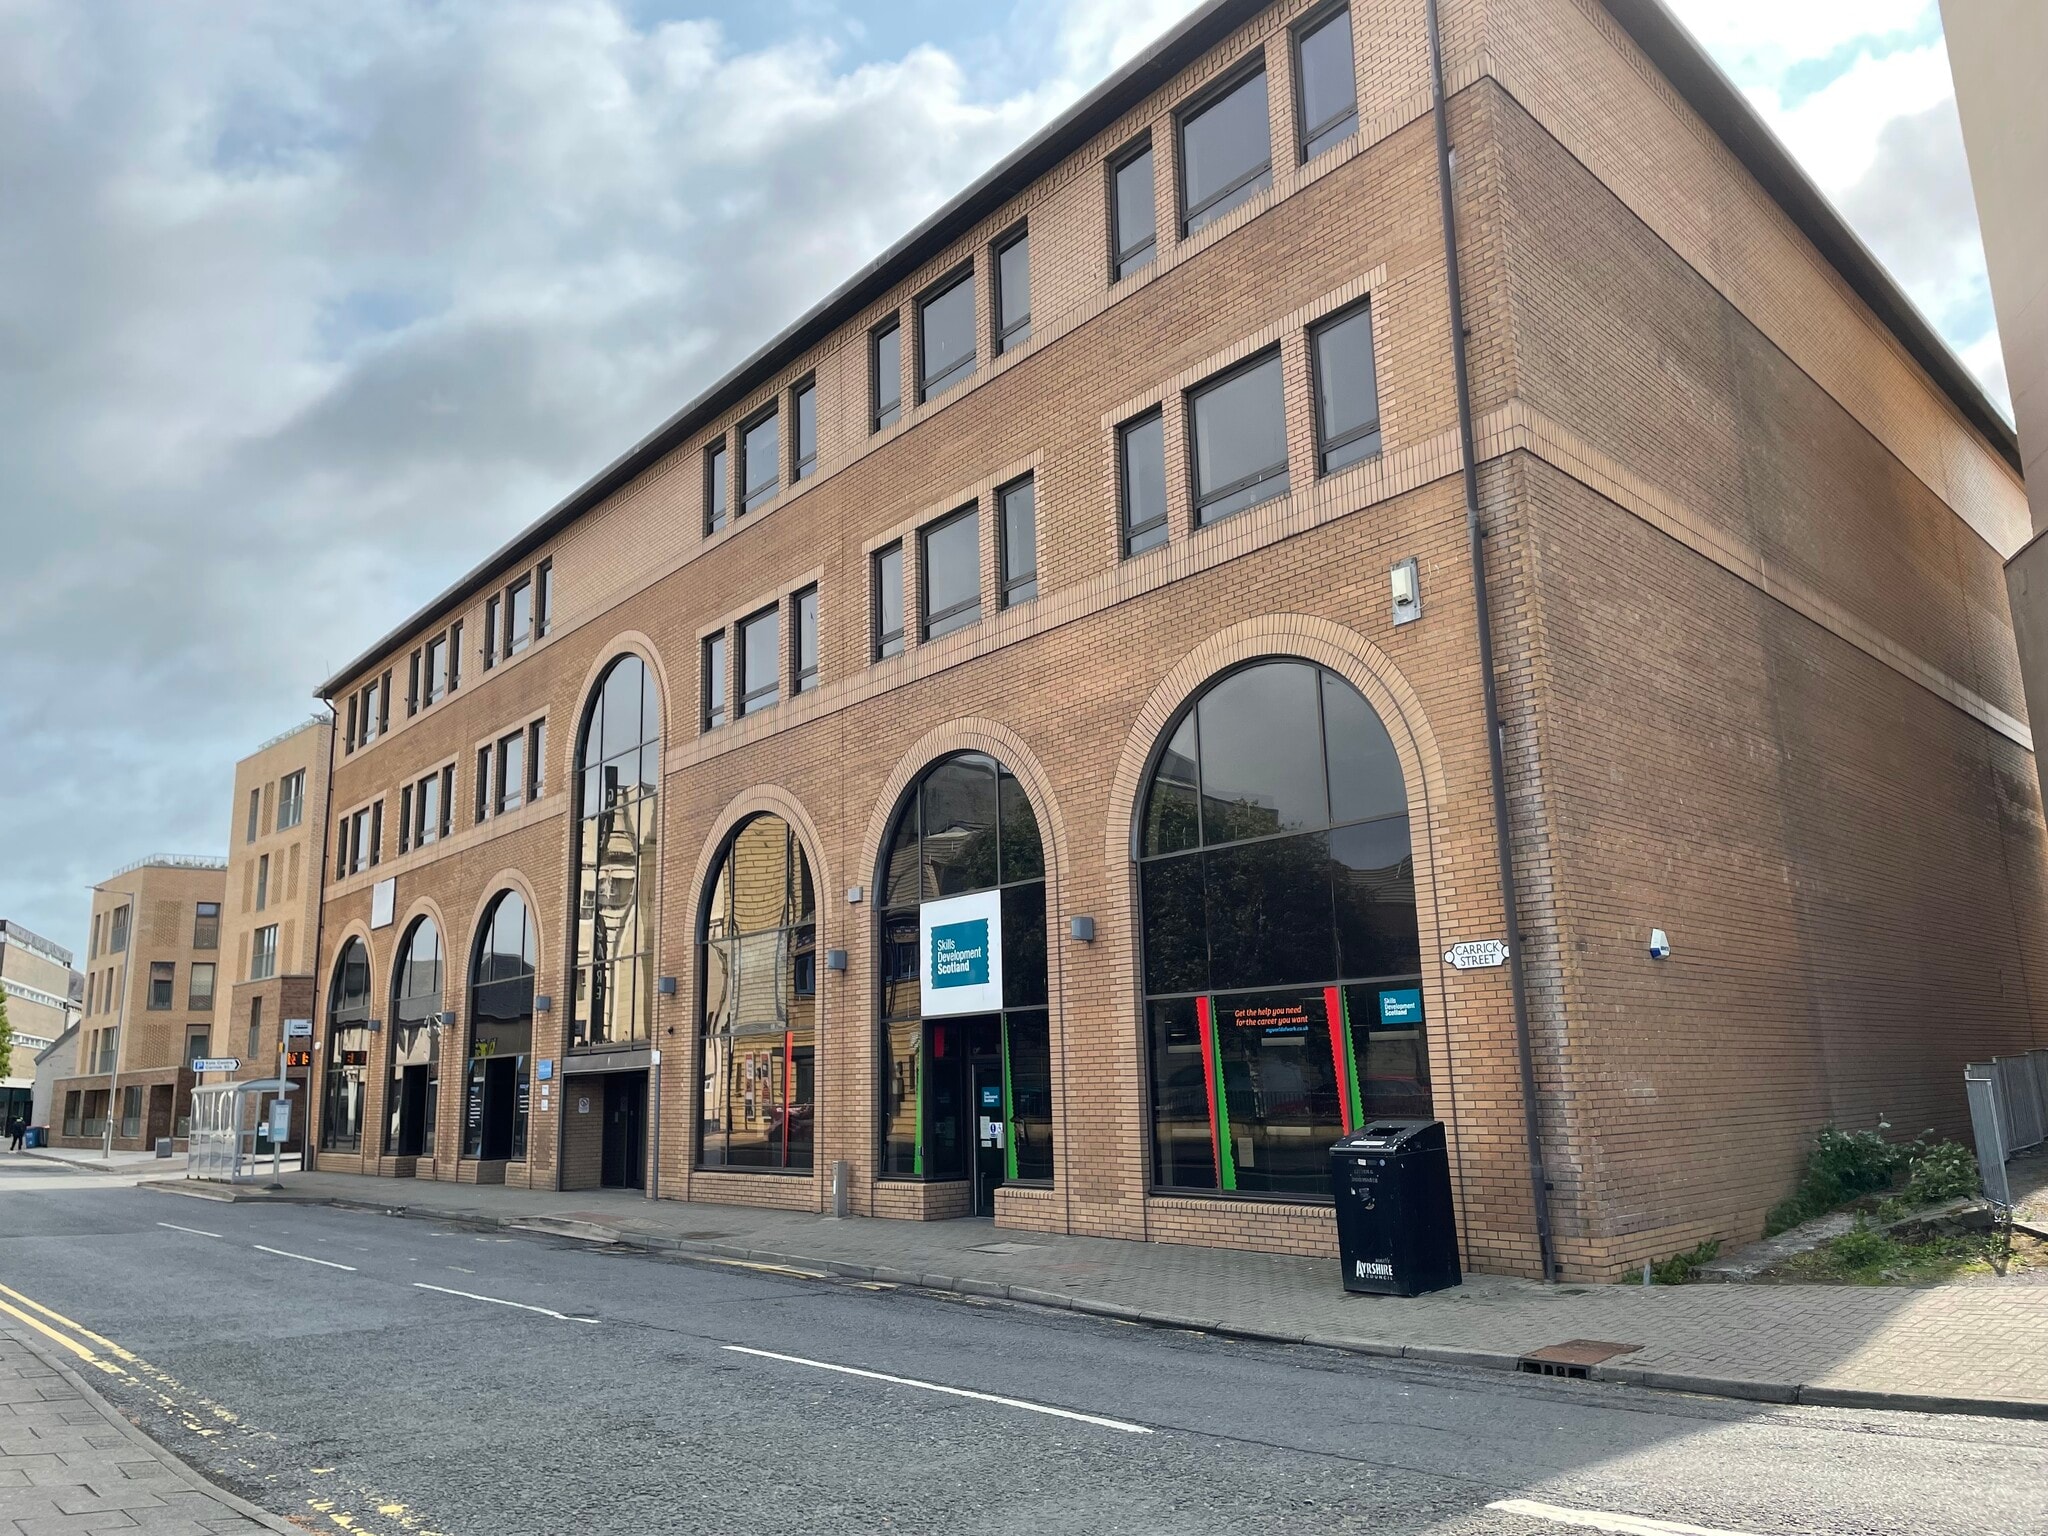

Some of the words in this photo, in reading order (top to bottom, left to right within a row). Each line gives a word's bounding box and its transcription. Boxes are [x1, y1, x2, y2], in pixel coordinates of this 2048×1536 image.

[937, 938, 956, 951] Skills
[1455, 942, 1500, 956] CARRICK
[937, 946, 982, 963] Development
[1460, 953, 1496, 967] STREET
[937, 959, 970, 975] Scotland
[1234, 1009, 1246, 1017] Get
[1246, 1008, 1257, 1016] the
[1257, 1007, 1272, 1017] help
[1272, 1007, 1285, 1017] you
[1285, 1005, 1302, 1014] need
[1384, 1002, 1416, 1010] Development
[1385, 1008, 1408, 1016] Scotland
[1236, 1018, 1246, 1026] for
[1246, 1017, 1257, 1026] the
[1257, 1018, 1277, 1026] career
[1278, 1017, 1291, 1027] you
[1291, 1015, 1308, 1023] want
[1356, 1260, 1394, 1278] AYRSHIRE
[1365, 1273, 1393, 1281] COUNCIL
